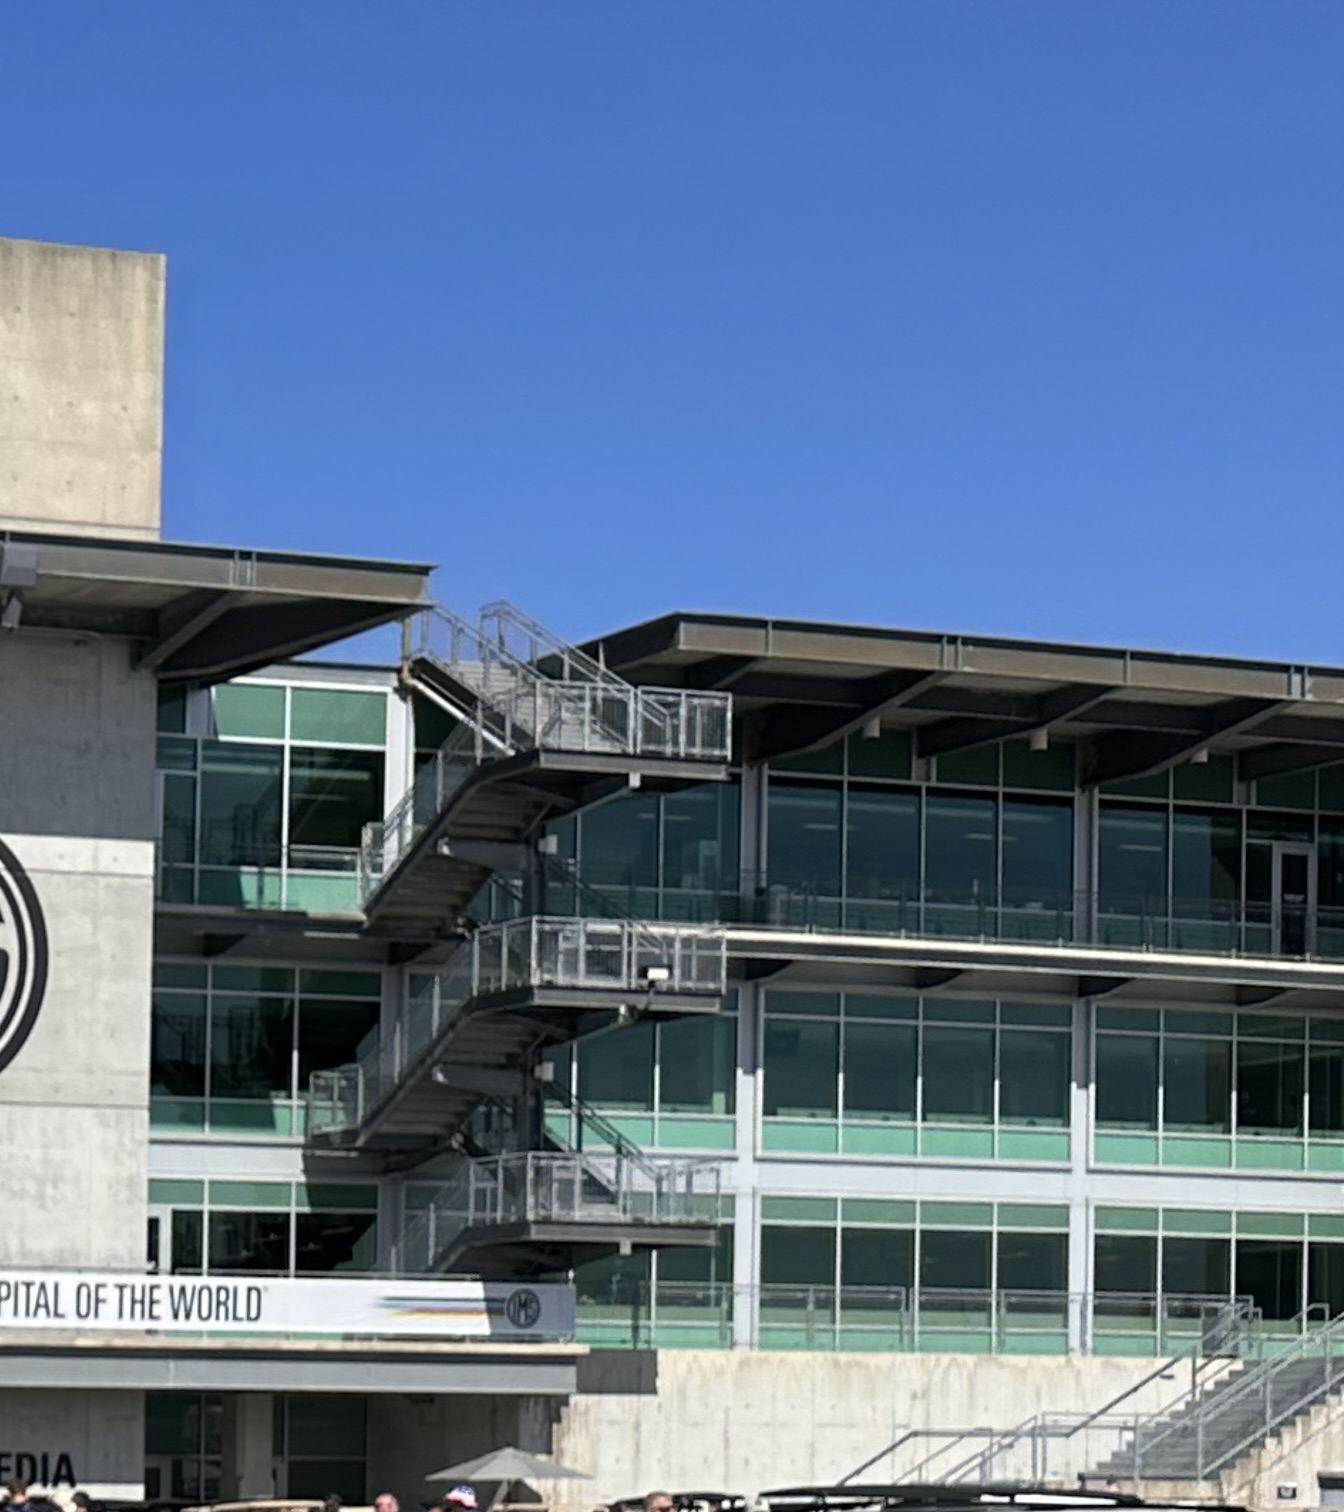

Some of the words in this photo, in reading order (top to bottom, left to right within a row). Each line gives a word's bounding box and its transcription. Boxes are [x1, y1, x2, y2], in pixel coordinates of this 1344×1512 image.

[75, 1281, 108, 1320] OF
[115, 1282, 162, 1321] THE
[169, 1284, 263, 1323] WORLD
